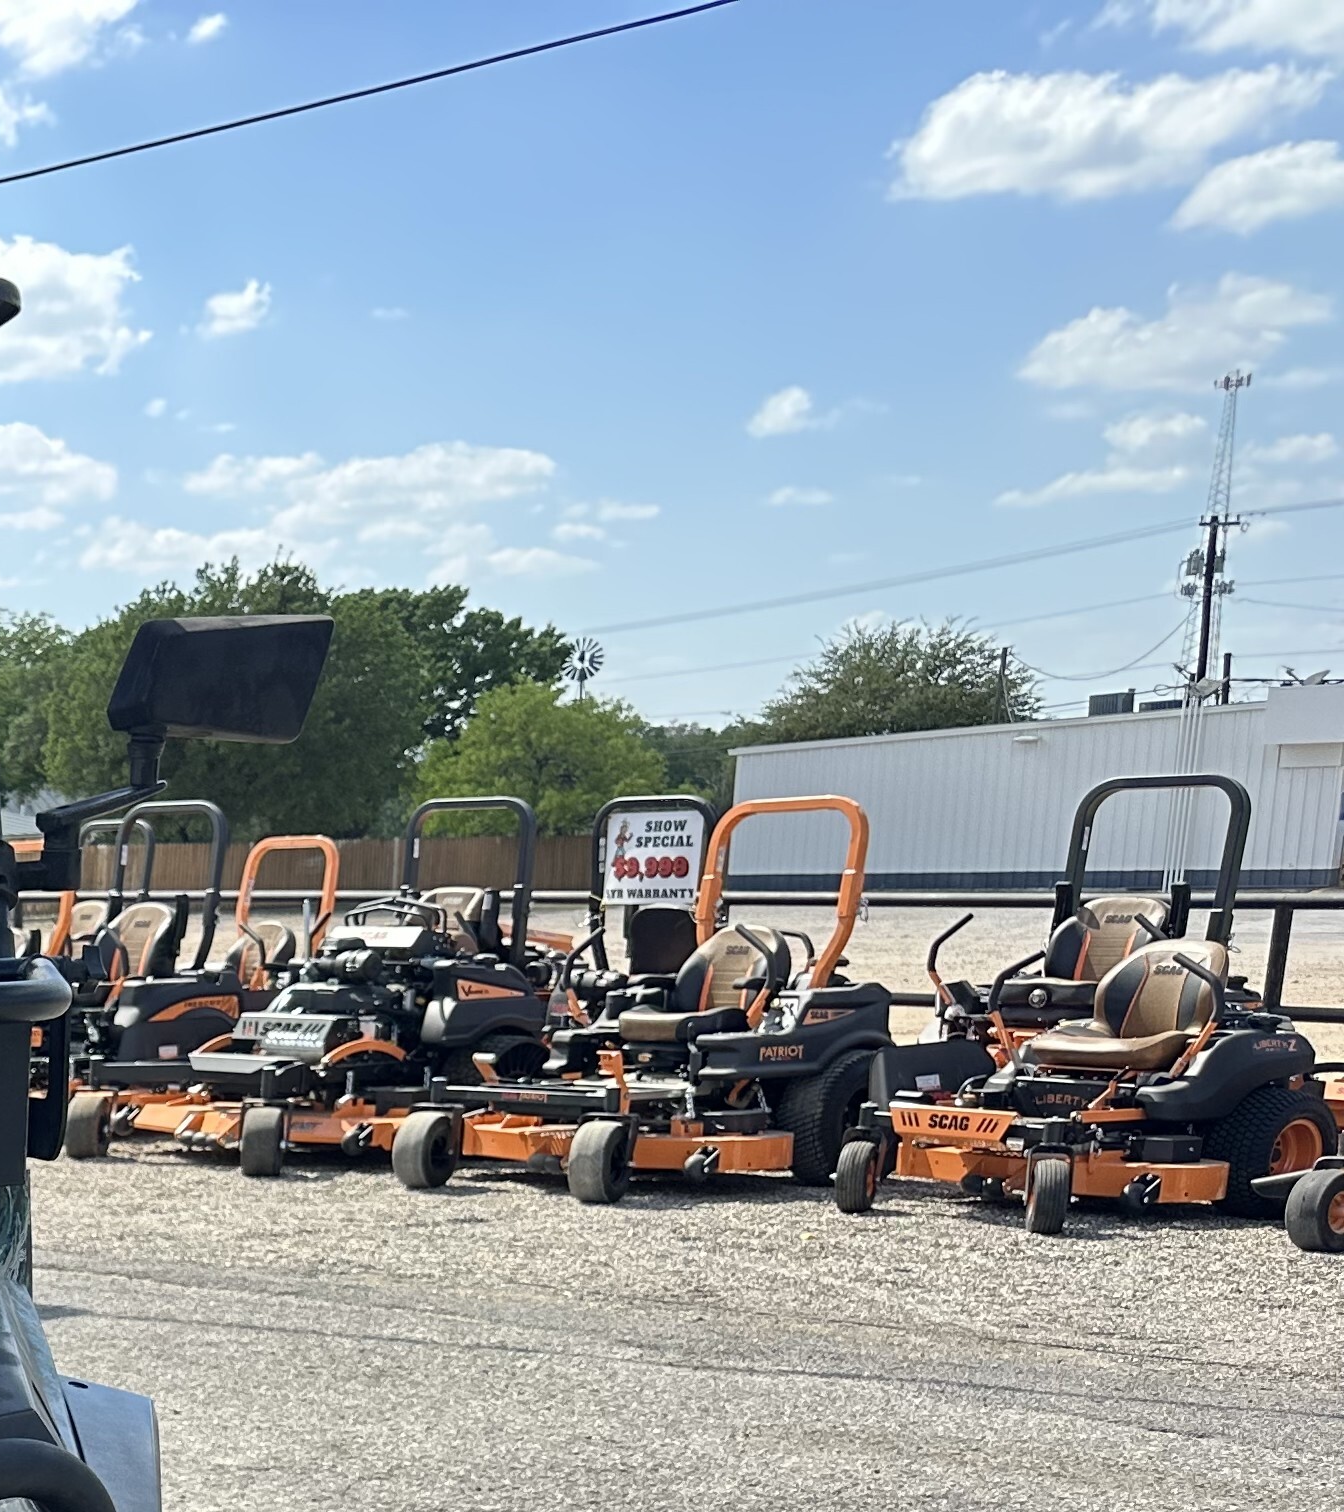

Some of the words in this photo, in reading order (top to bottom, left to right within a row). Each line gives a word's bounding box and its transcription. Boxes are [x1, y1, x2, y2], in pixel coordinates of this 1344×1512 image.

[645, 819, 687, 832] SHOW
[635, 834, 694, 847] SPECIAL
[627, 887, 694, 899] WARRANTY
[1254, 1038, 1284, 1050] LIBERTY
[759, 1044, 804, 1061] PATRIOT
[1035, 1093, 1089, 1109] LIBERTY
[928, 1114, 970, 1131] SCAG
